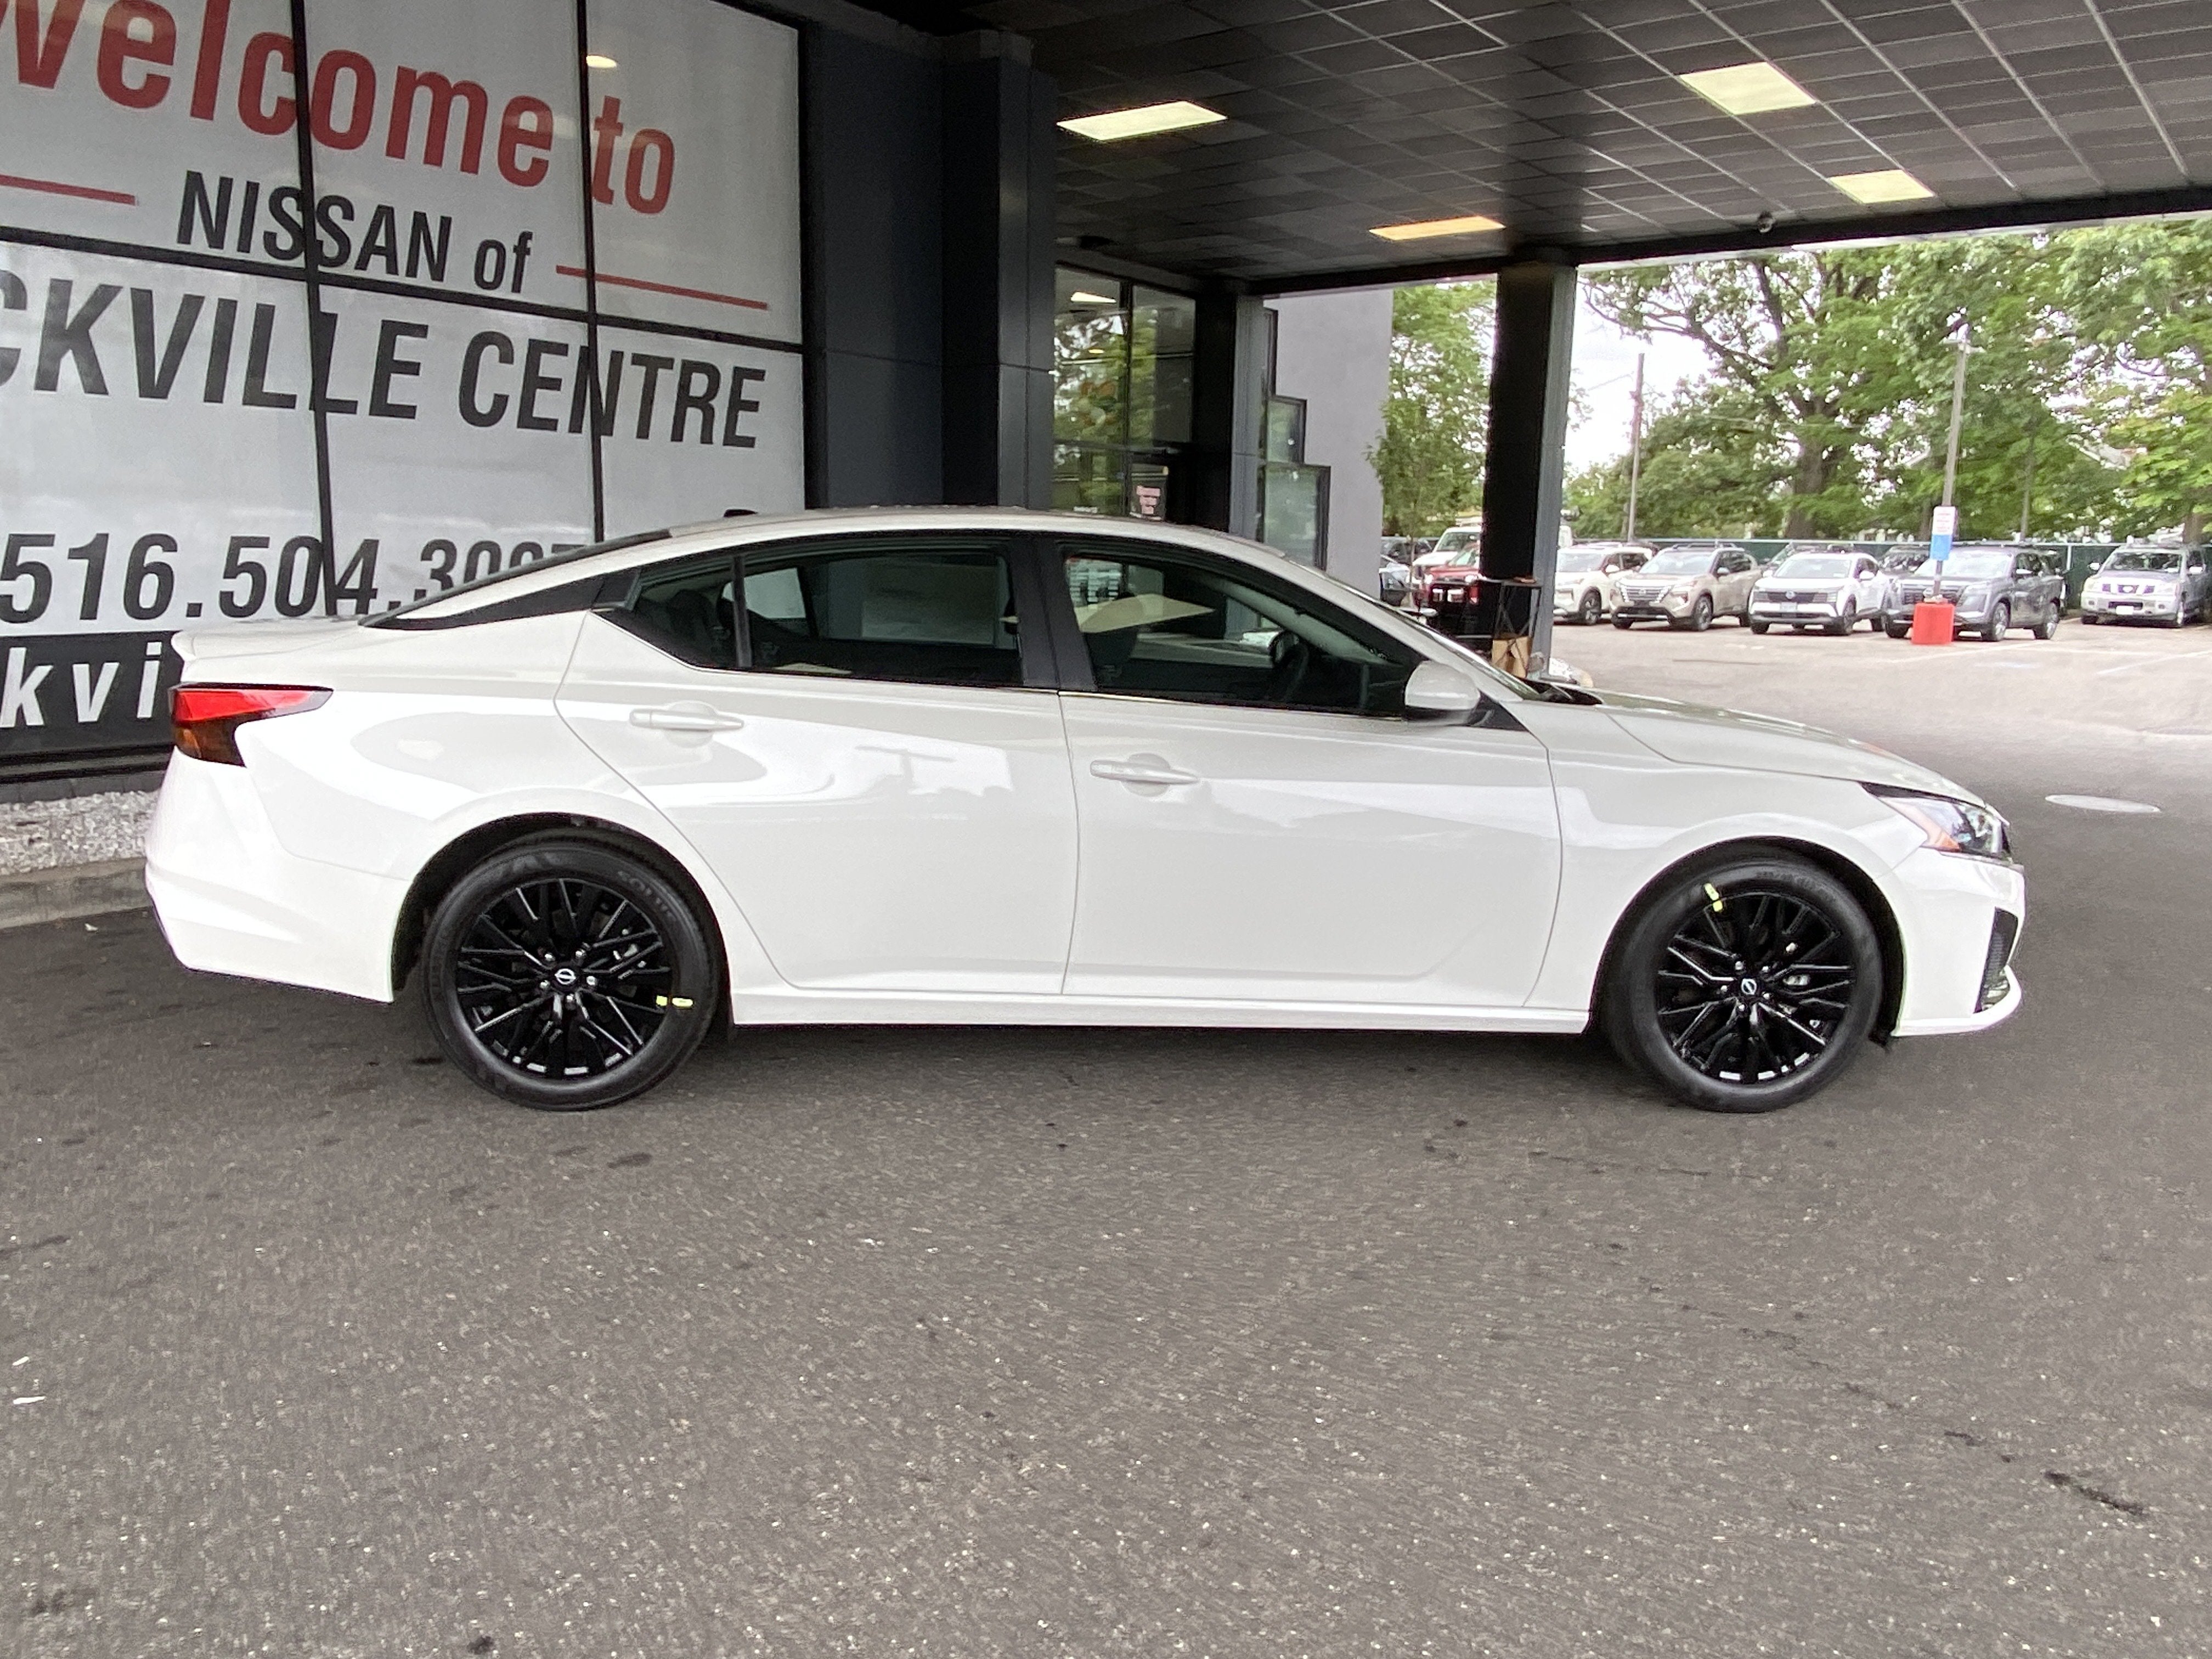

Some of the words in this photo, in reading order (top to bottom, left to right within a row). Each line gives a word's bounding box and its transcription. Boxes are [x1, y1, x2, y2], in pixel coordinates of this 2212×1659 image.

[591, 95, 675, 214] to
[176, 170, 452, 283] NISSAN
[473, 230, 533, 294] of
[458, 330, 766, 448] CENTRE
[0, 533, 589, 623] 516.504.30
